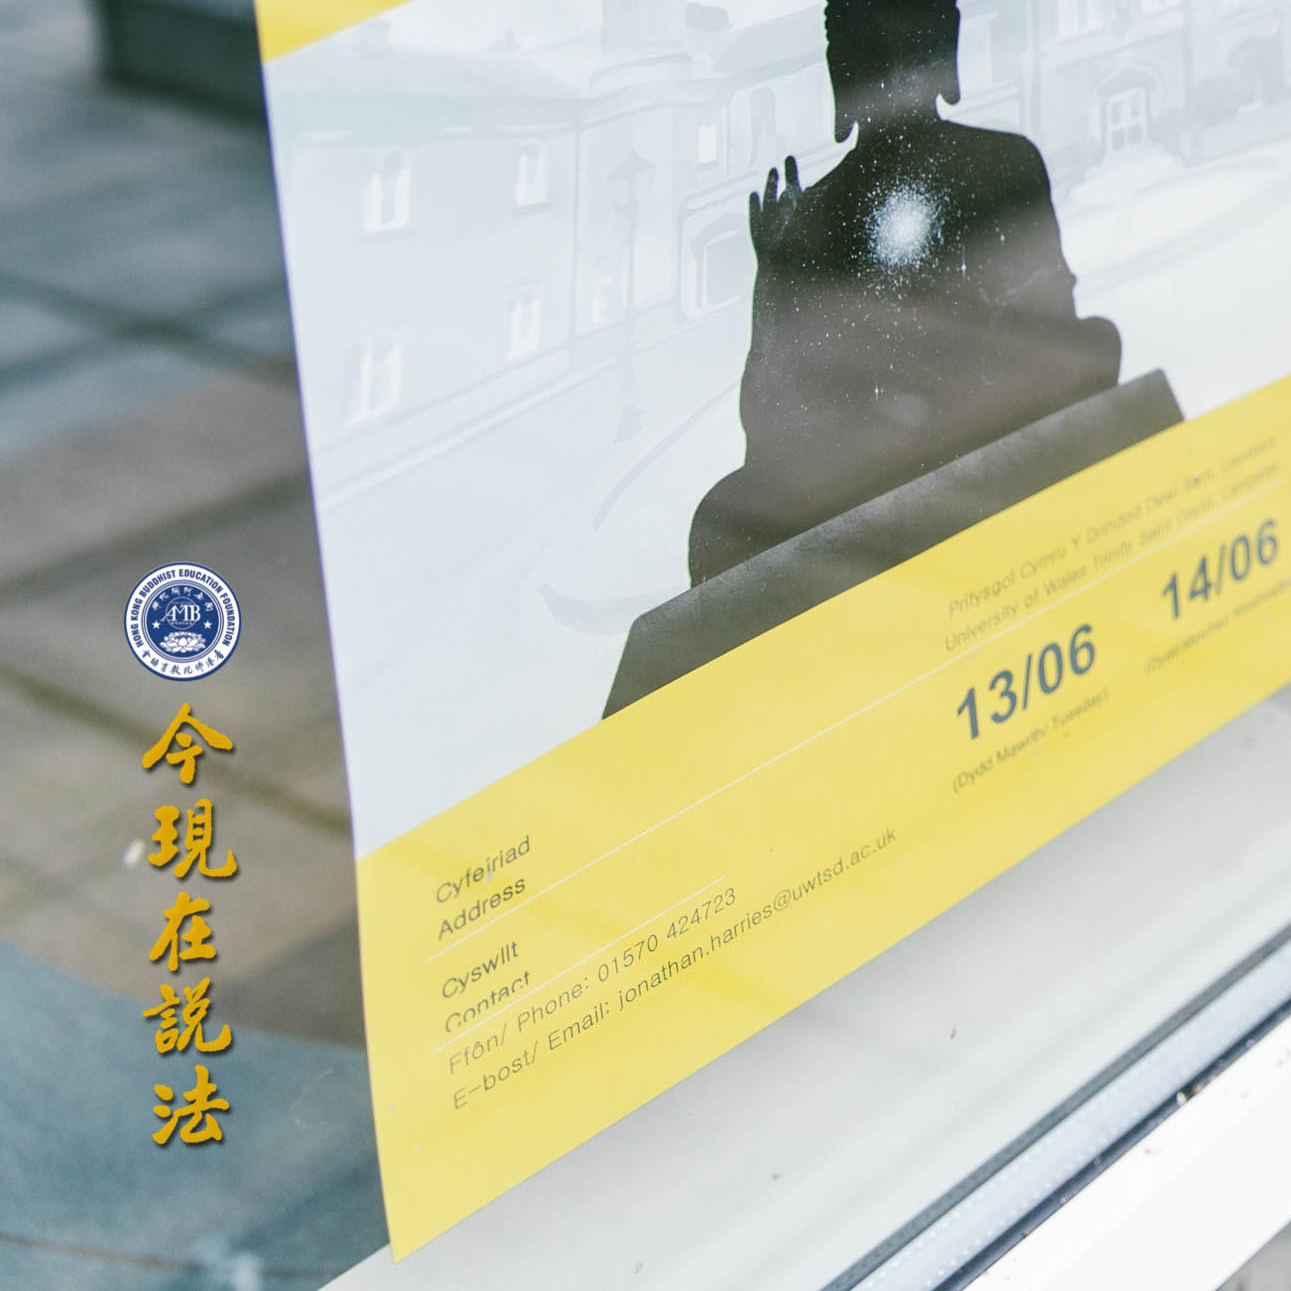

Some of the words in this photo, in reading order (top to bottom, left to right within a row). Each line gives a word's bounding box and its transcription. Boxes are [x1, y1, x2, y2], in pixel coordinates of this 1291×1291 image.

[949, 570, 1017, 617] Prifysgol
[1161, 519, 1279, 620] 14/06
[945, 602, 1017, 651] University
[957, 624, 1096, 740] 13/06
[952, 754, 994, 793] (Dydd
[435, 834, 531, 904] Cyfeiriad
[437, 877, 527, 941] Address
[548, 1003, 611, 1051] Email:
[617, 827, 898, 1013] jonathan.harries@uwtsd.ac.uk
[441, 941, 519, 1000] Cyswllt
[444, 970, 531, 1034] Contact
[448, 1020, 508, 1076] Ffôn/
[516, 975, 590, 1033] Phone:
[598, 933, 658, 983] 01570
[666, 887, 738, 940] 424723
